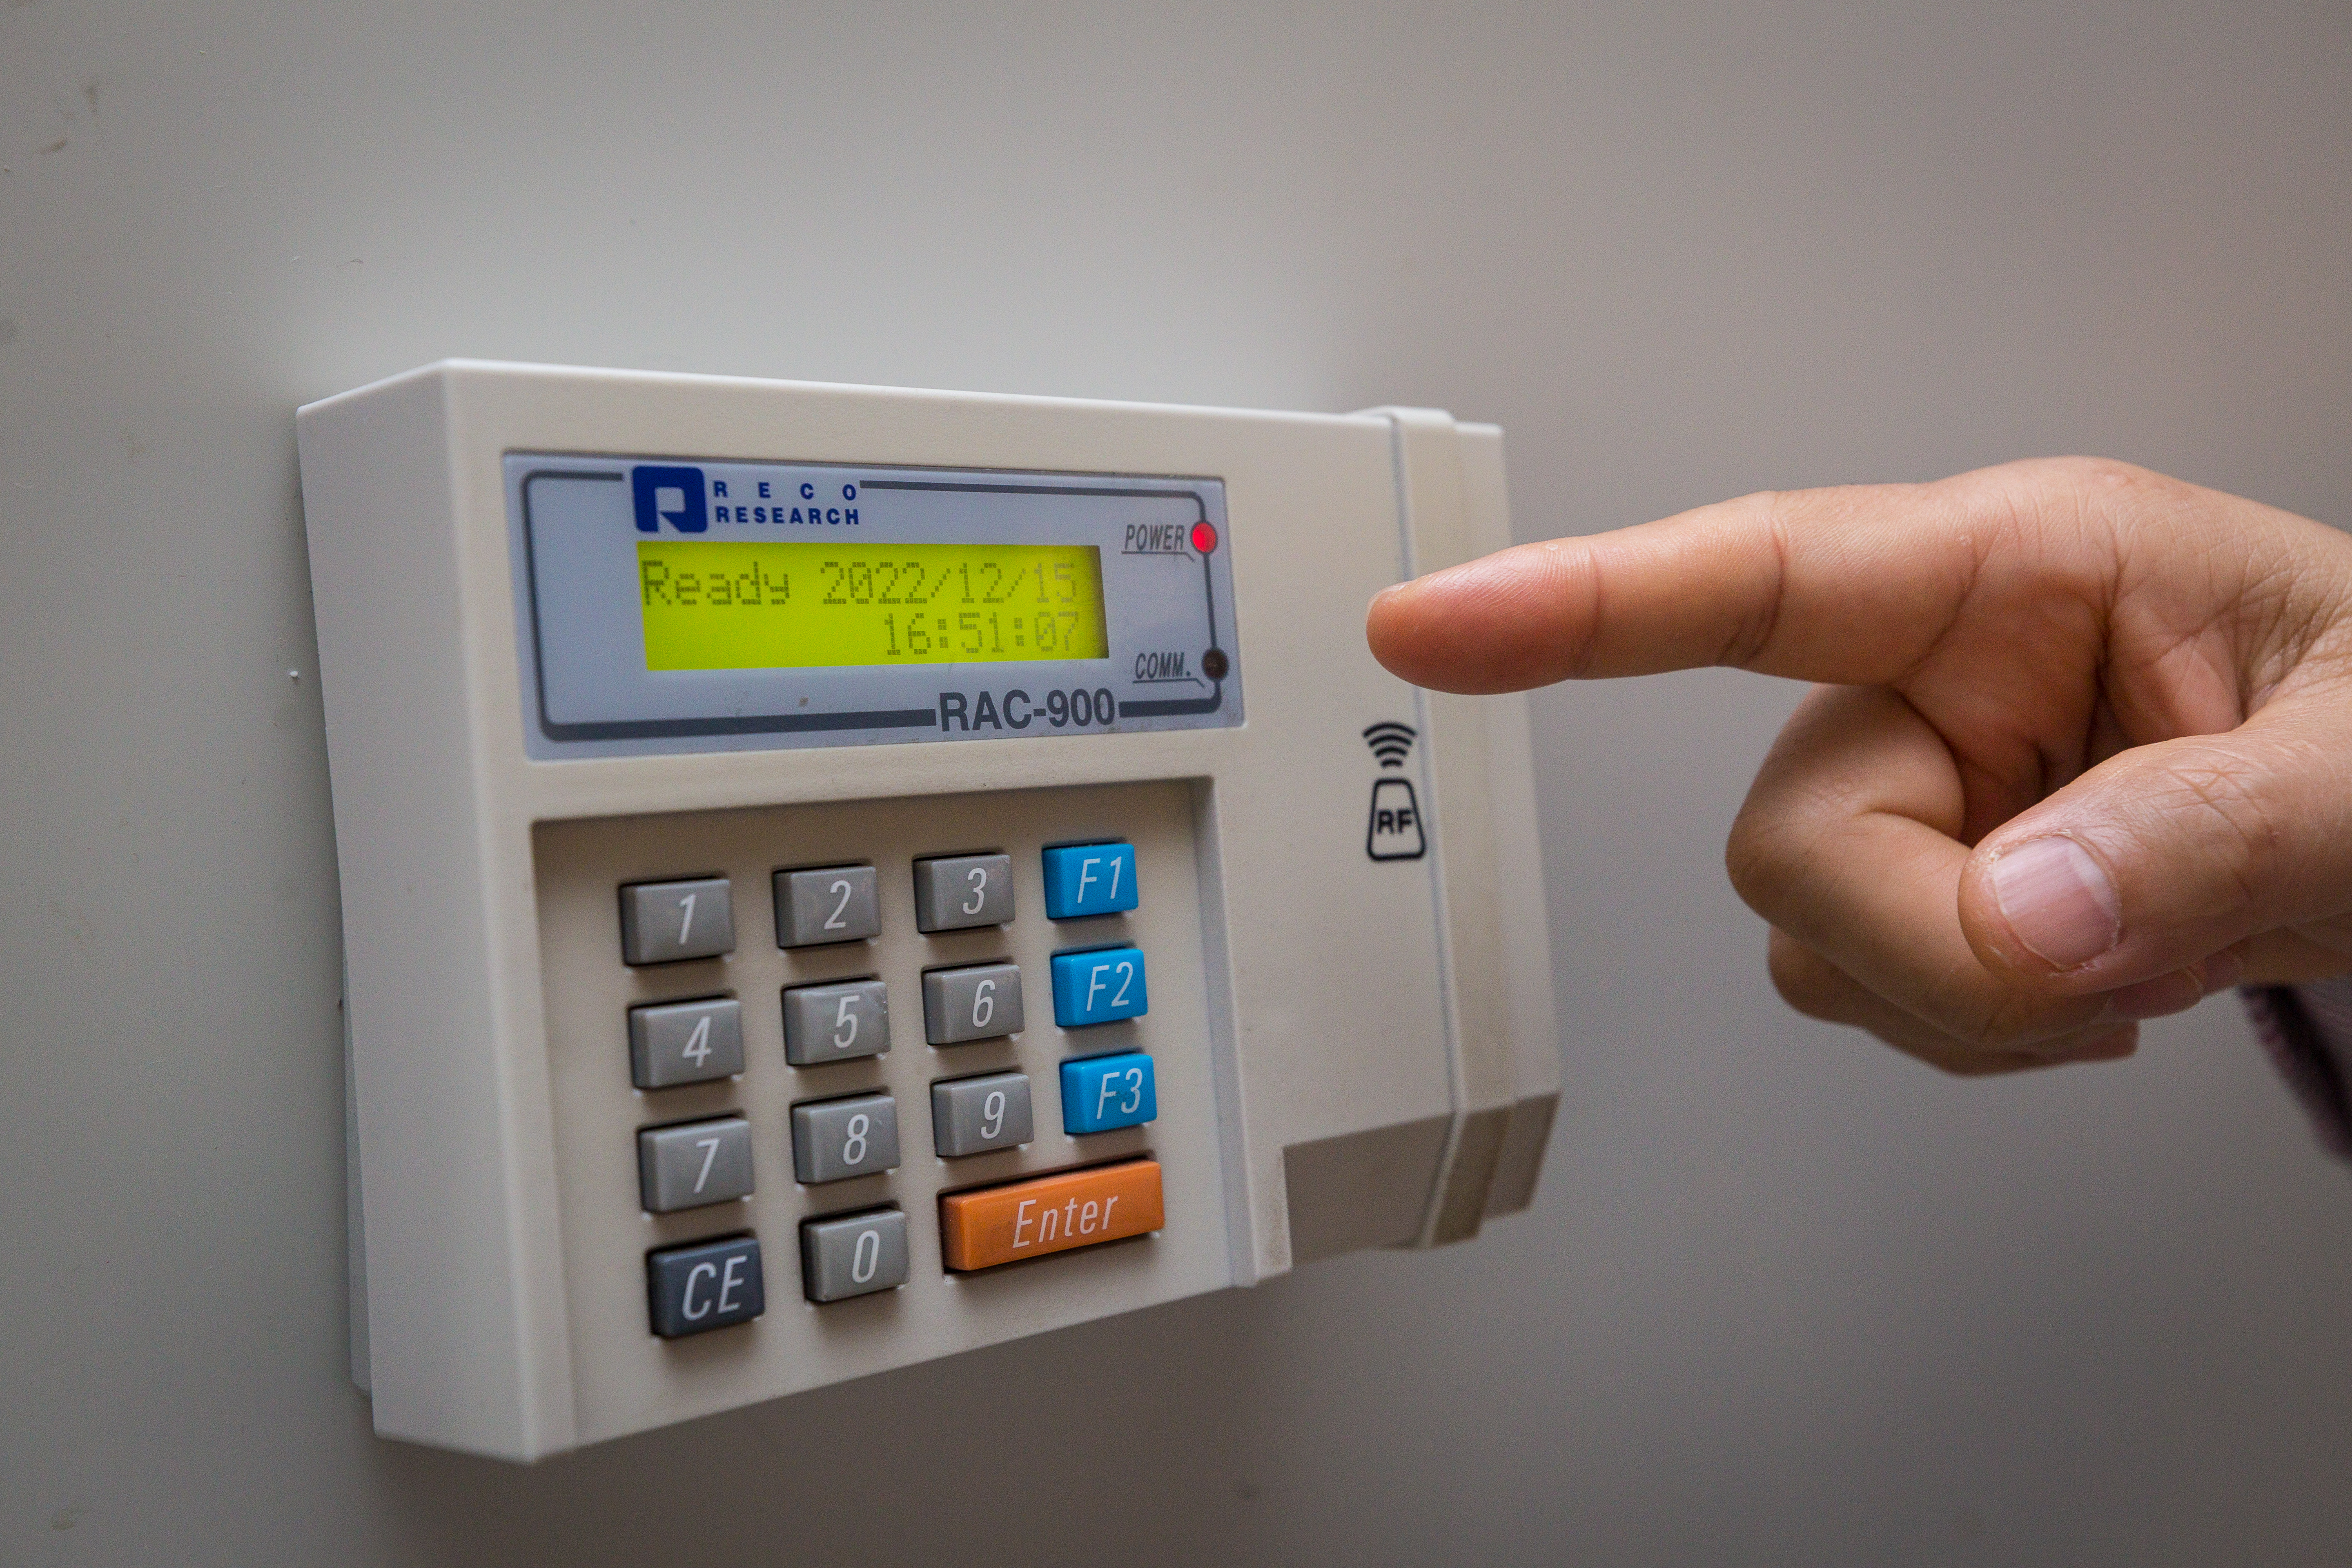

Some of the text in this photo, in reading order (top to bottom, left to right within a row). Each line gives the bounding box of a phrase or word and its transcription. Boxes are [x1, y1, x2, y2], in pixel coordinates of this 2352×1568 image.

[713, 480, 856, 501] RECO
[715, 506, 859, 525] RESEARCH
[1125, 524, 1185, 550] POWER
[642, 560, 1077, 606] Ready 2022/12/15
[884, 611, 1078, 655] 16:51:07
[1135, 652, 1191, 679] COMM.
[939, 688, 1115, 732] RAC-900
[1377, 808, 1413, 834] RF
[963, 868, 987, 914] 3
[1077, 857, 1122, 904] F1
[679, 894, 696, 944] 1
[824, 880, 851, 930] 2
[972, 980, 996, 1027] 6
[1086, 961, 1134, 1012] F2
[682, 1017, 711, 1068] 4
[834, 995, 860, 1047] 5
[980, 1091, 1005, 1139] 9
[1096, 1068, 1142, 1120] F3
[843, 1114, 869, 1165] 8
[694, 1138, 719, 1193] 7
[1012, 1194, 1118, 1249] Enter
[852, 1230, 879, 1283] 0
[682, 1254, 747, 1321] CE
